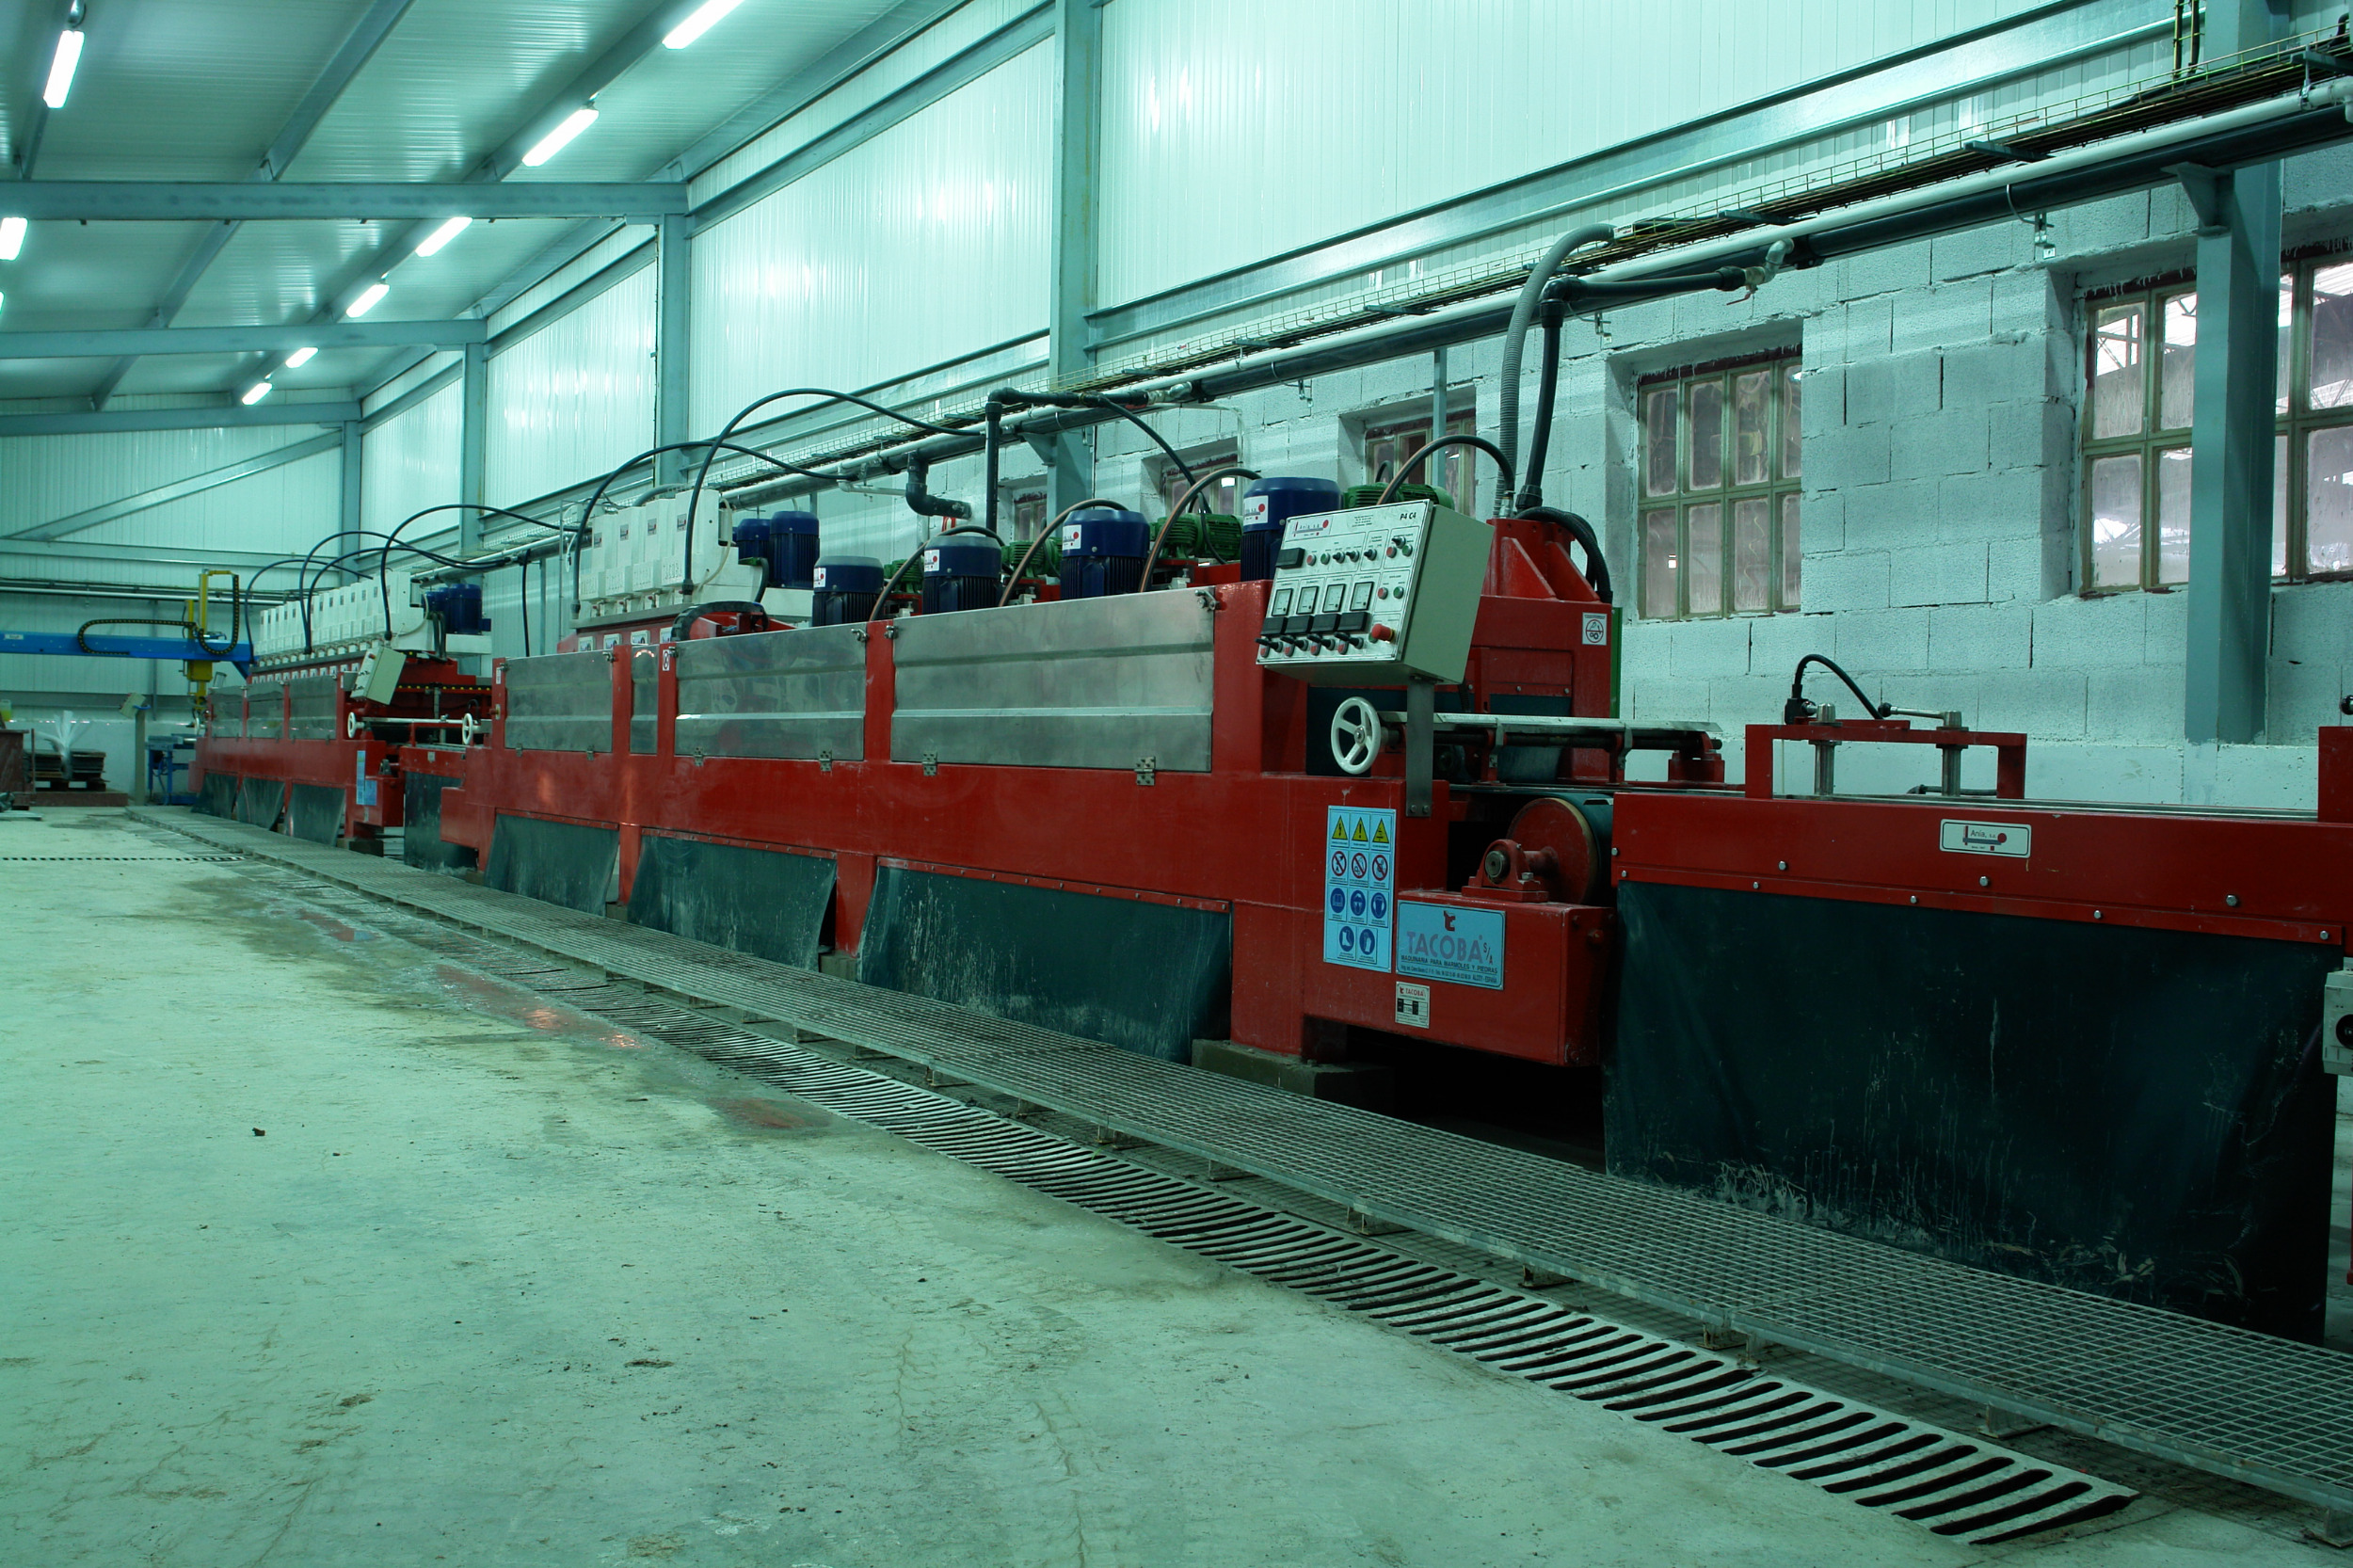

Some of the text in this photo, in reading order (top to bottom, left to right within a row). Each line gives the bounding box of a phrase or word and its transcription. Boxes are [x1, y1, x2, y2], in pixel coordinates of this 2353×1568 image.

[1407, 932, 1482, 964] TACOBA
[1401, 954, 1428, 963] MAQUINARIA
[1444, 960, 1469, 968] MARMOLES
[1478, 965, 1498, 973] PIEDRAS
